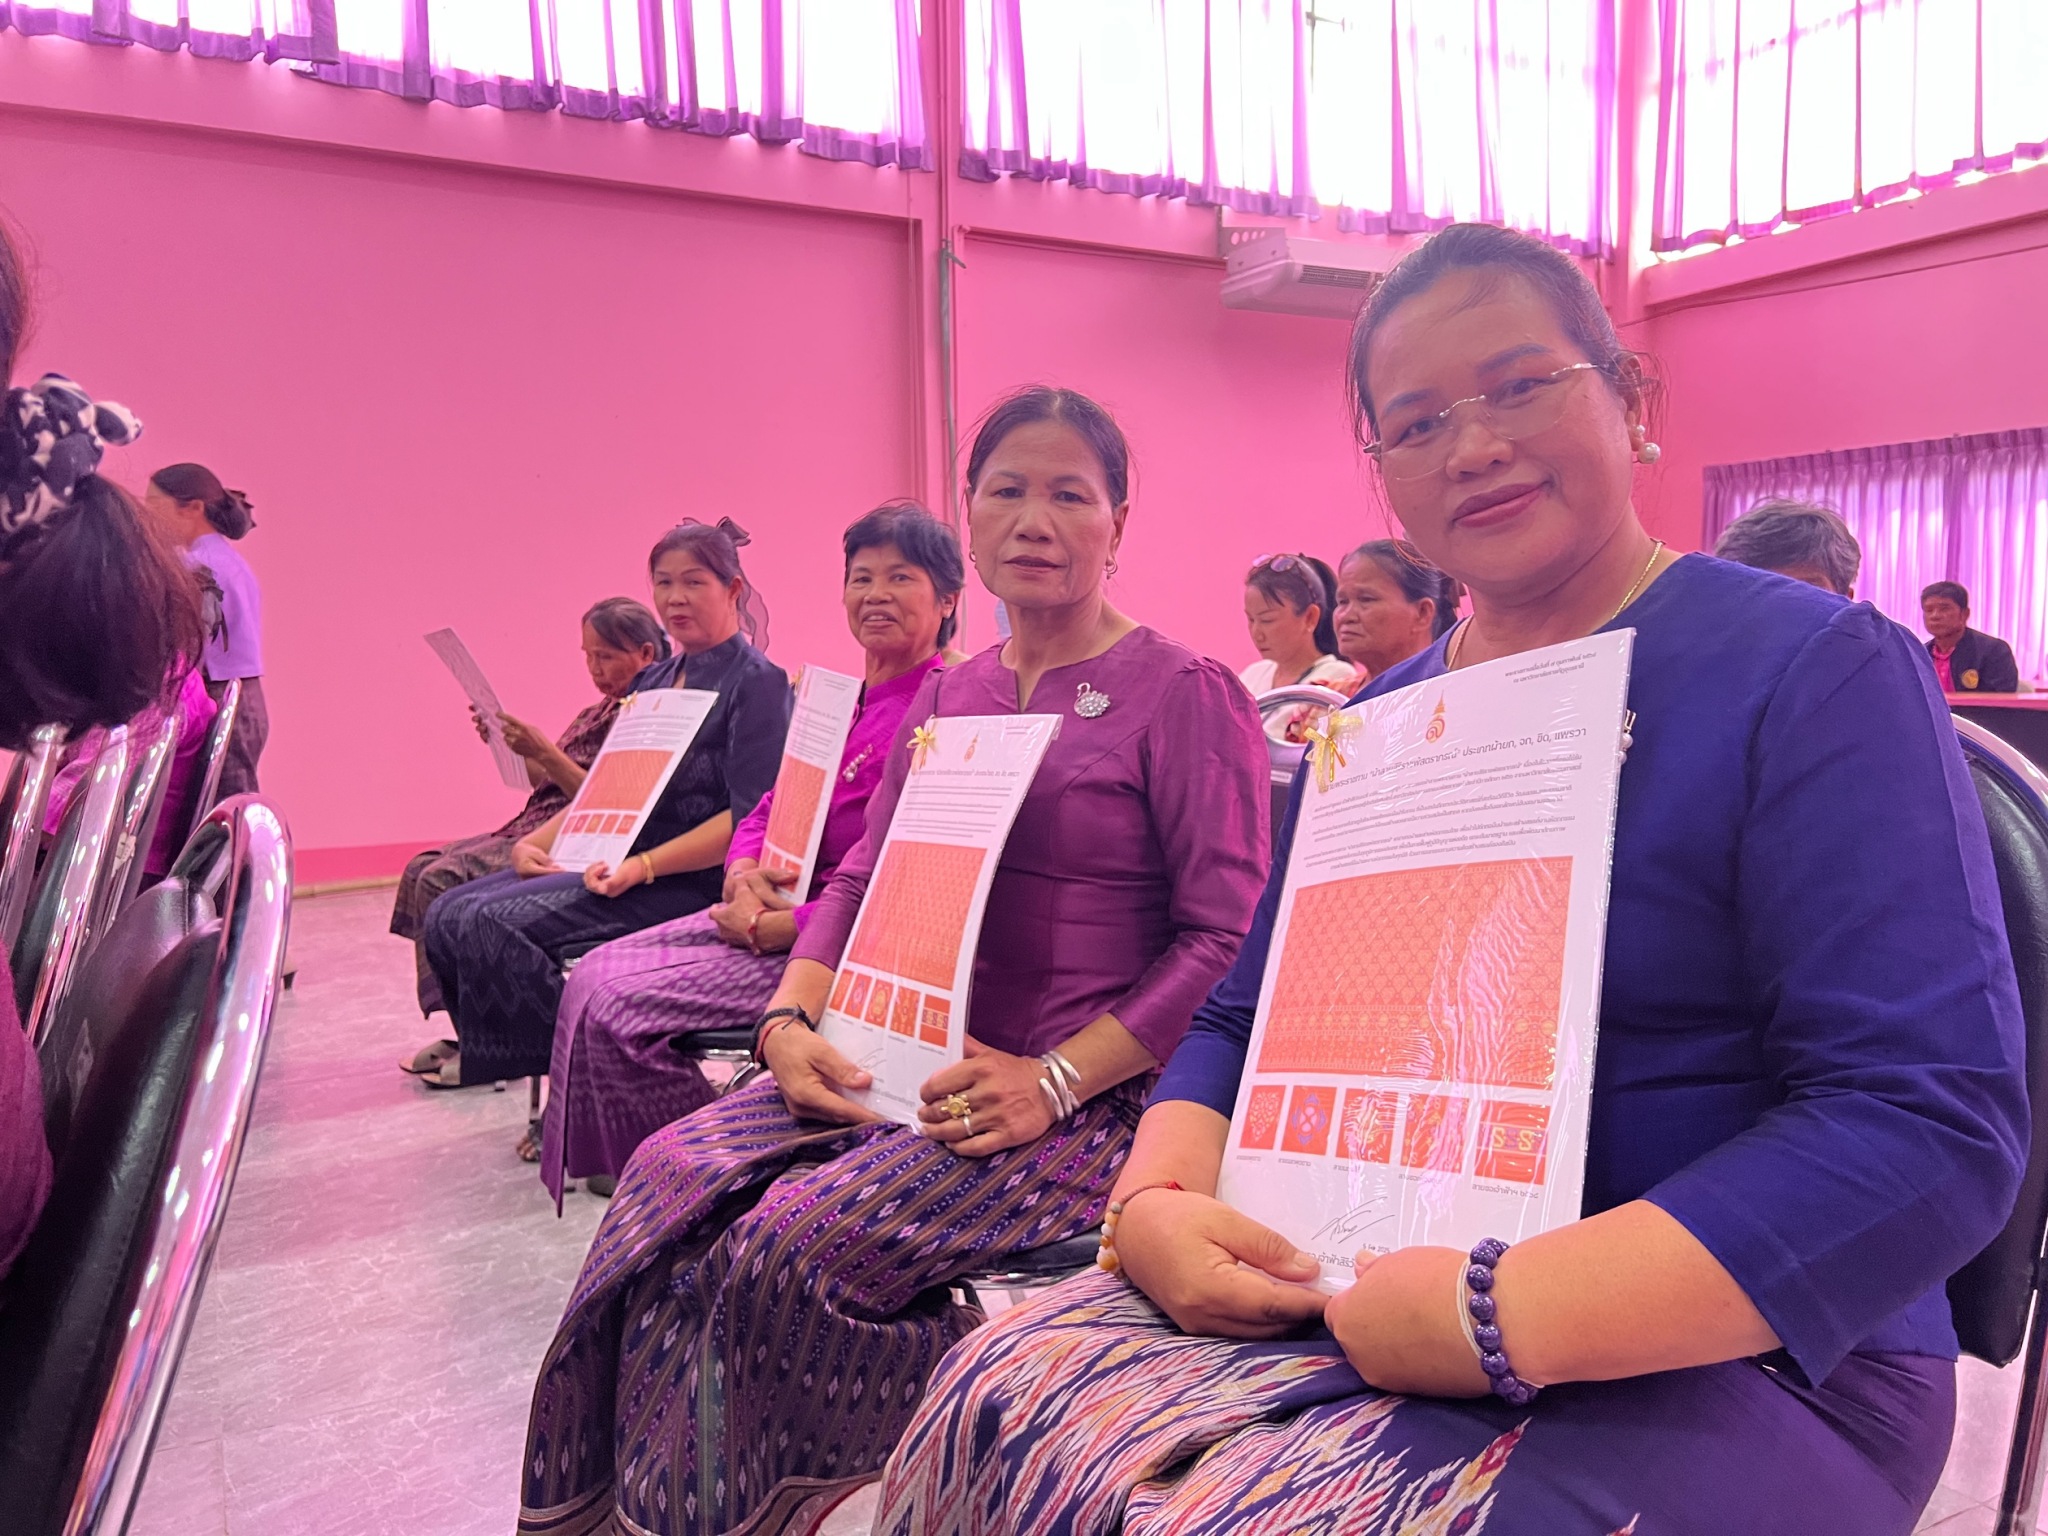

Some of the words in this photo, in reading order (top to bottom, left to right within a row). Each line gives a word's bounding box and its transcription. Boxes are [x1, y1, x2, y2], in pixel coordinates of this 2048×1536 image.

[1462, 740, 1517, 757] ประเภทผ้ายก,
[1519, 737, 1534, 746] จก,
[1554, 727, 1587, 741] แพรวา
